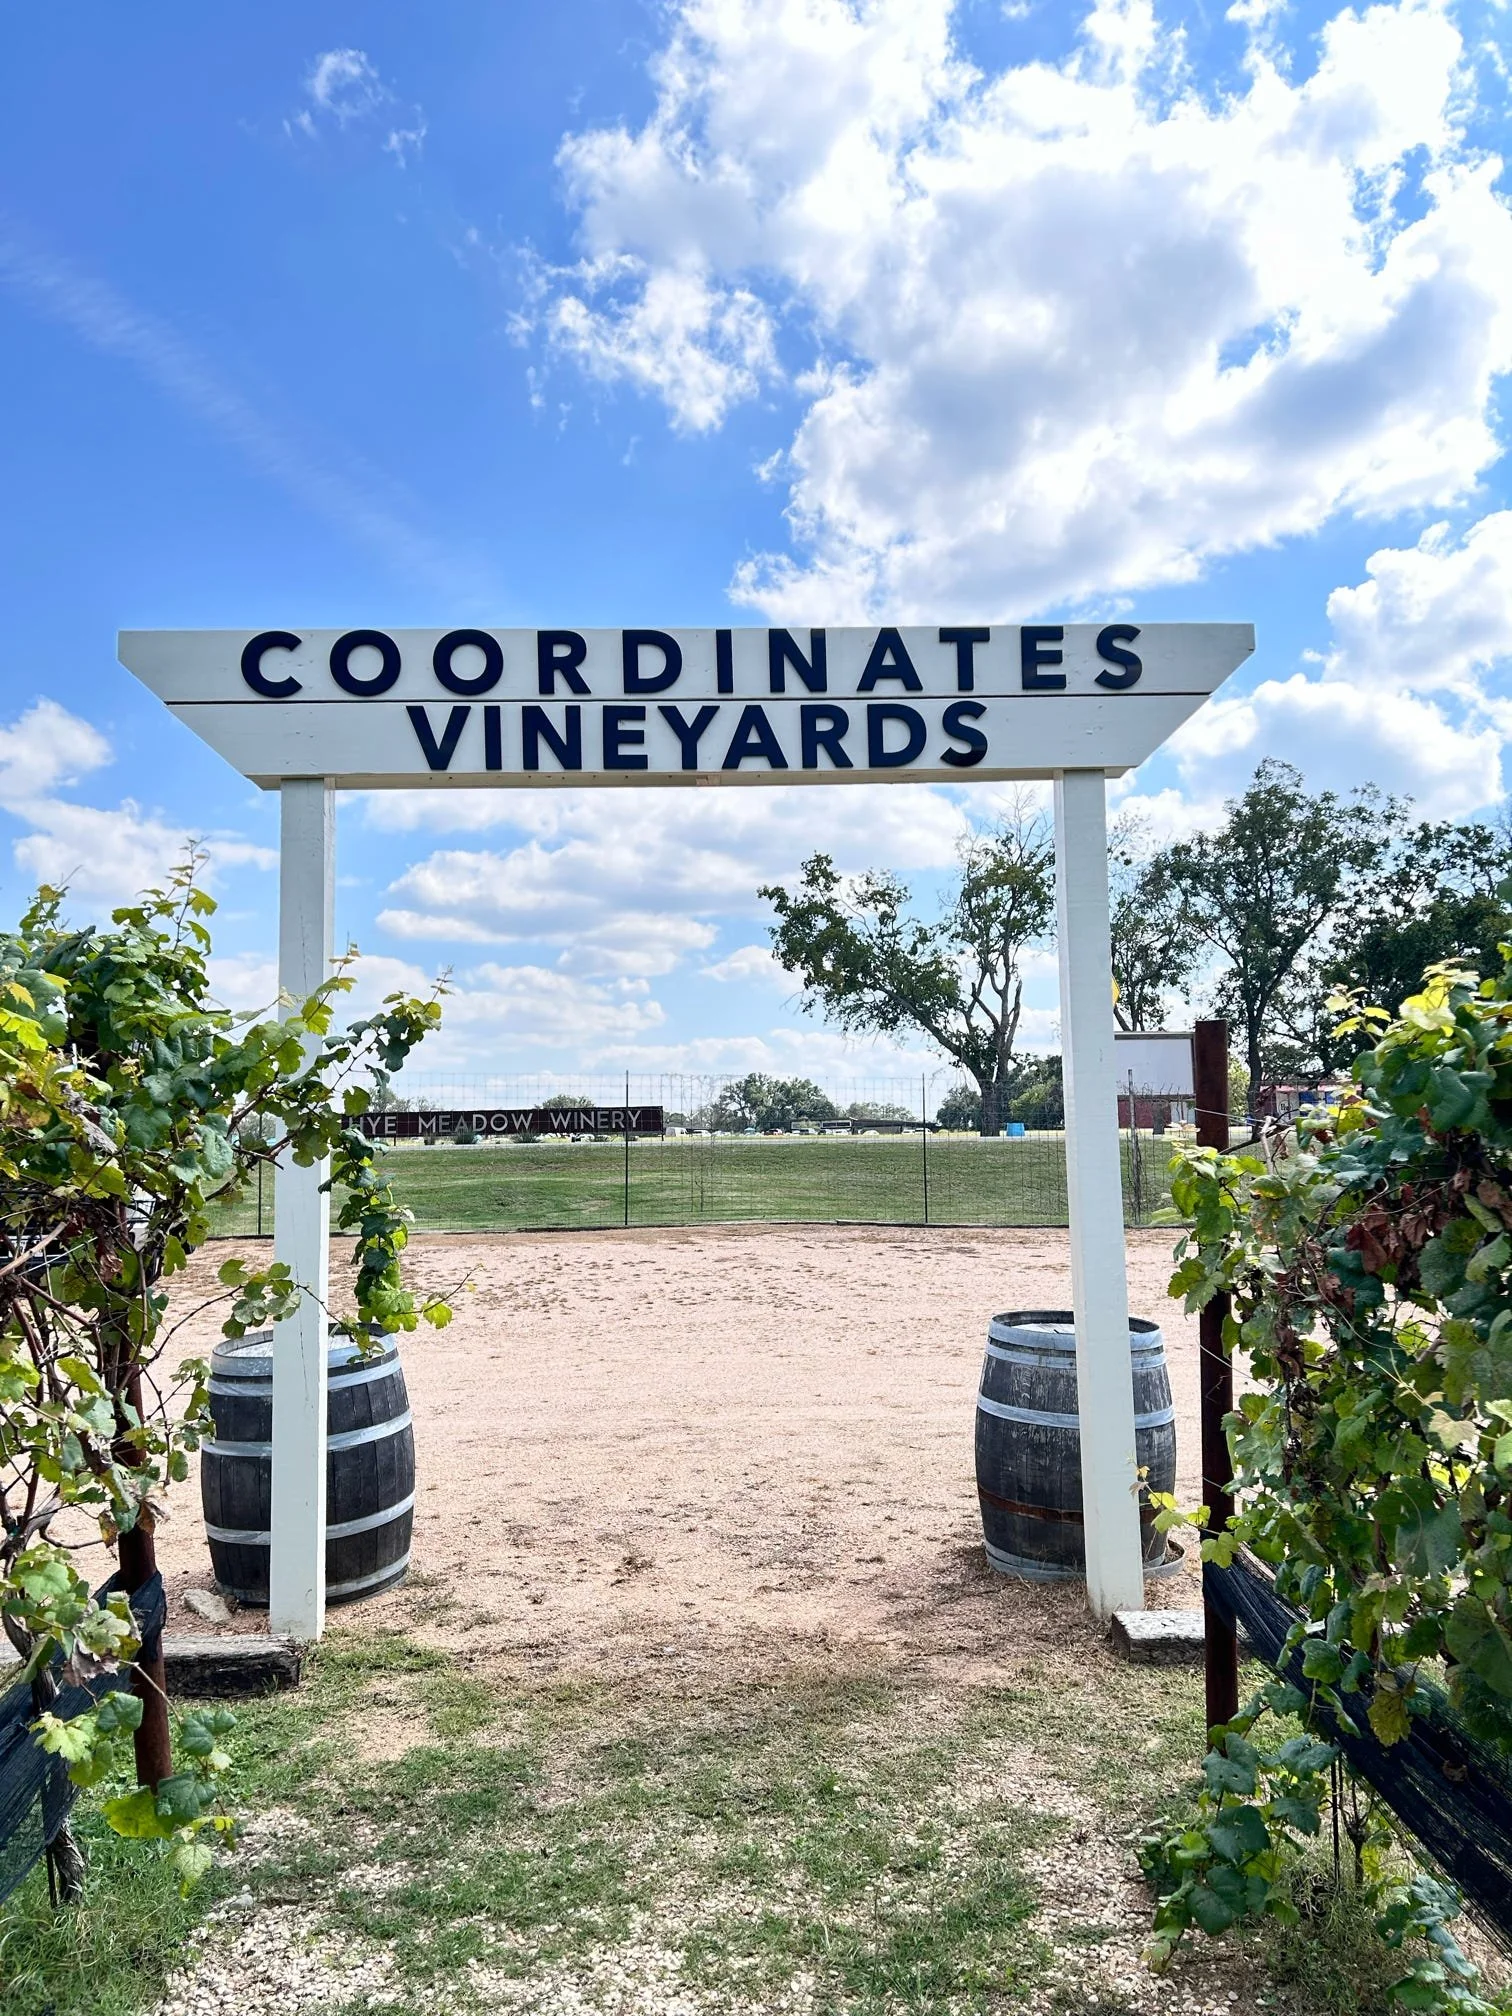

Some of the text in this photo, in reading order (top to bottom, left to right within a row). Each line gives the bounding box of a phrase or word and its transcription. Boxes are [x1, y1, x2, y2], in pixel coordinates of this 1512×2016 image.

[241, 624, 1142, 698] COORDINATES
[406, 701, 987, 771] VINEYARDS
[348, 1110, 643, 1135] HYE MEADOW WINERY
